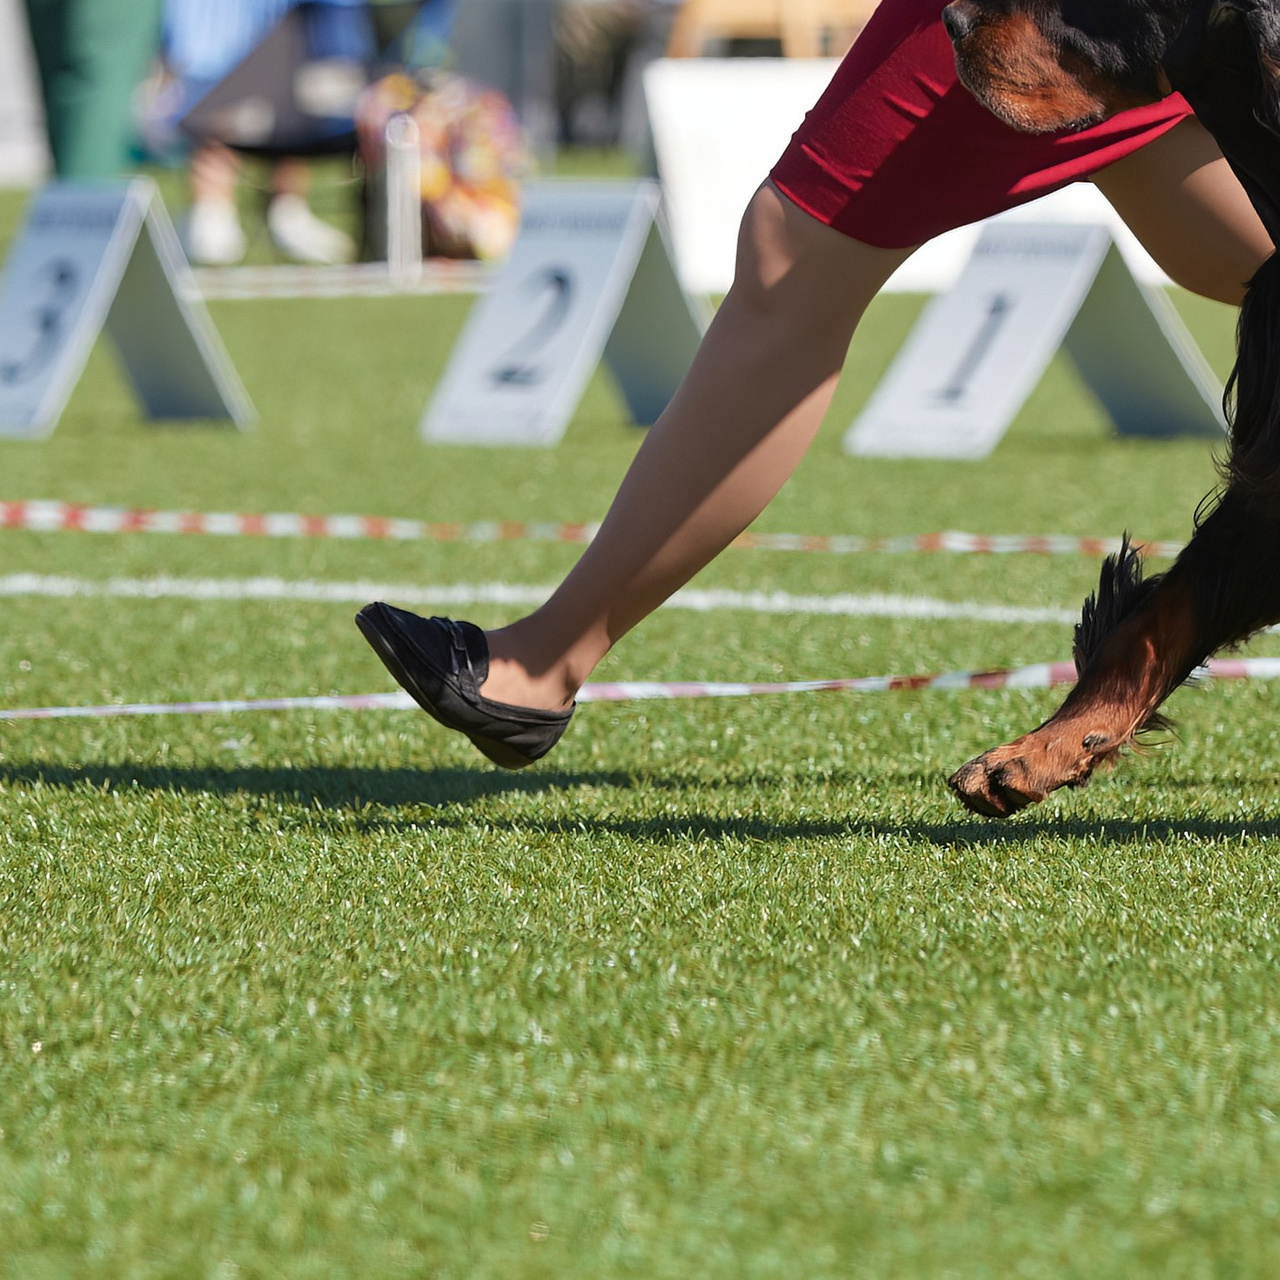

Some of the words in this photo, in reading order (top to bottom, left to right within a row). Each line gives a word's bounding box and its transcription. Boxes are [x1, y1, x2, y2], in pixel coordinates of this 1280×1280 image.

[0, 258, 80, 388] 3
[487, 266, 575, 388] 2
[928, 291, 1014, 406] 1
